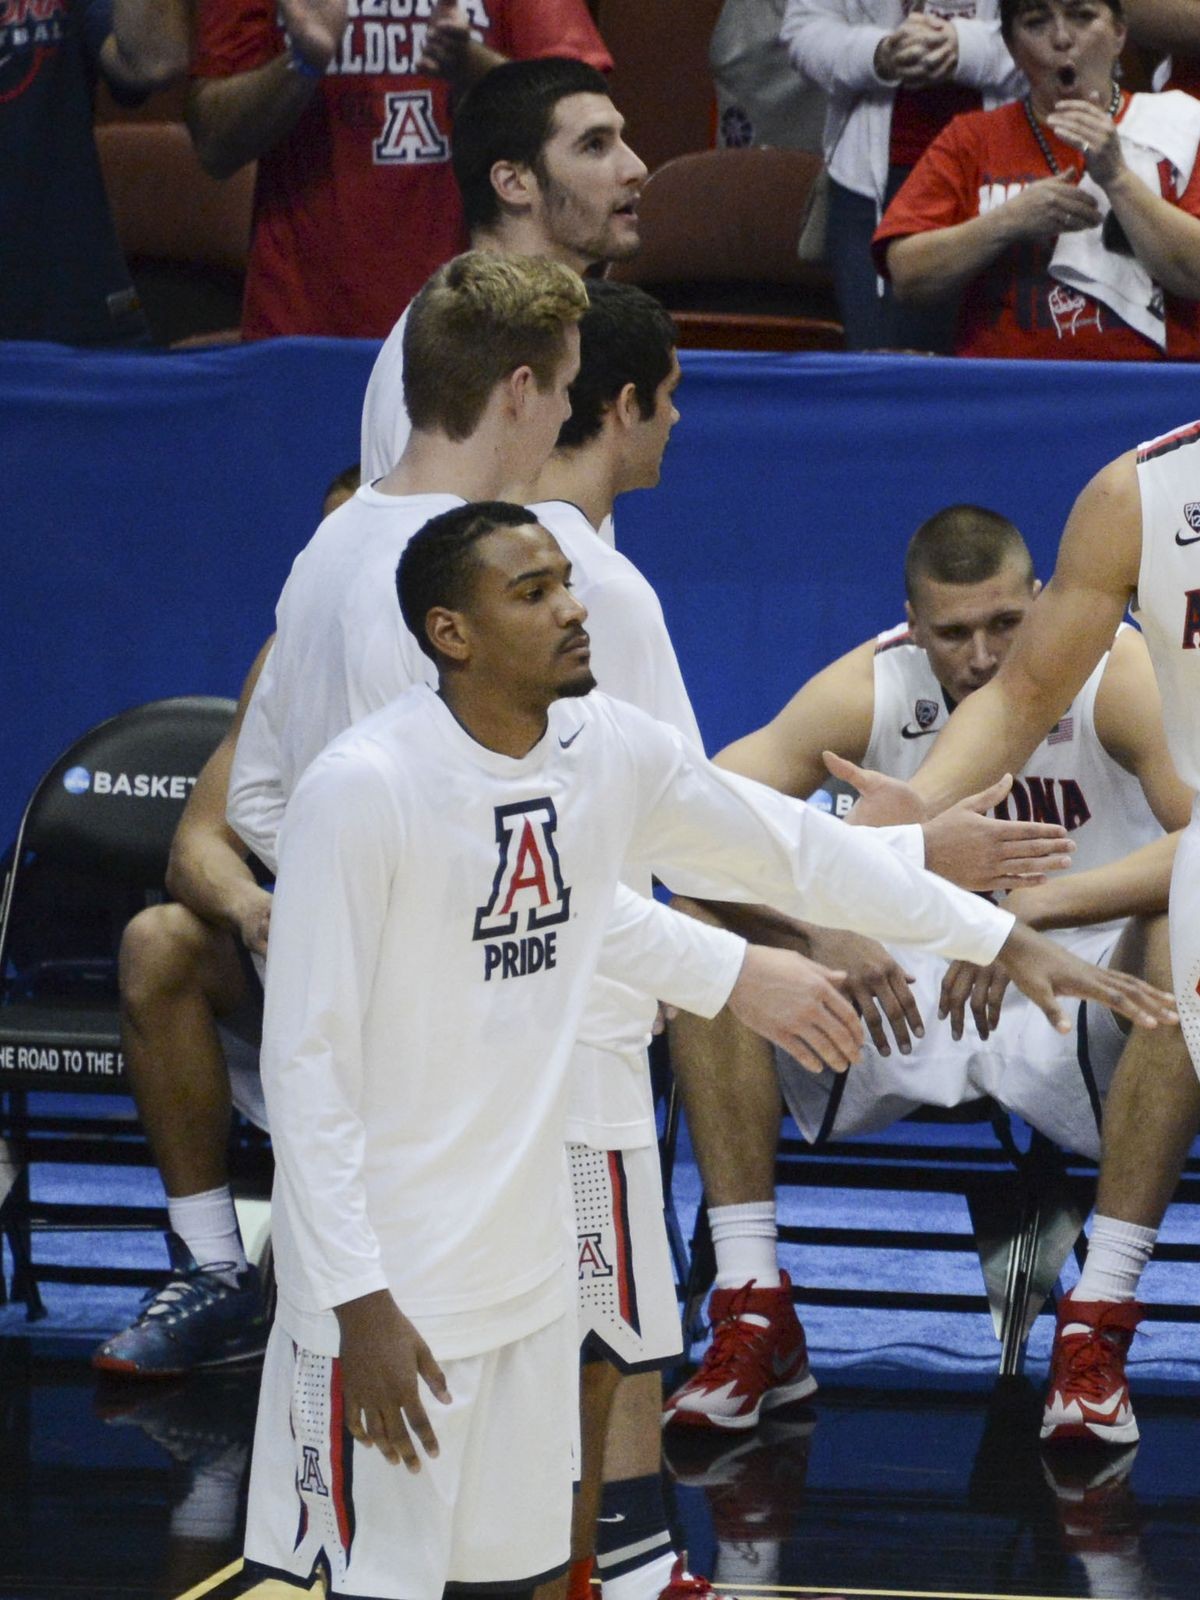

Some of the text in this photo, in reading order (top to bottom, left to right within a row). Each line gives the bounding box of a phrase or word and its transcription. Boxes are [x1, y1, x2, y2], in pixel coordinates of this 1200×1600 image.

[373, 90, 450, 165] A
[472, 796, 572, 941] A
[484, 931, 557, 981] PRIDE
[18, 1047, 59, 1071] ROAD
[62, 1050, 83, 1073] TO
[85, 1051, 114, 1075] THE
